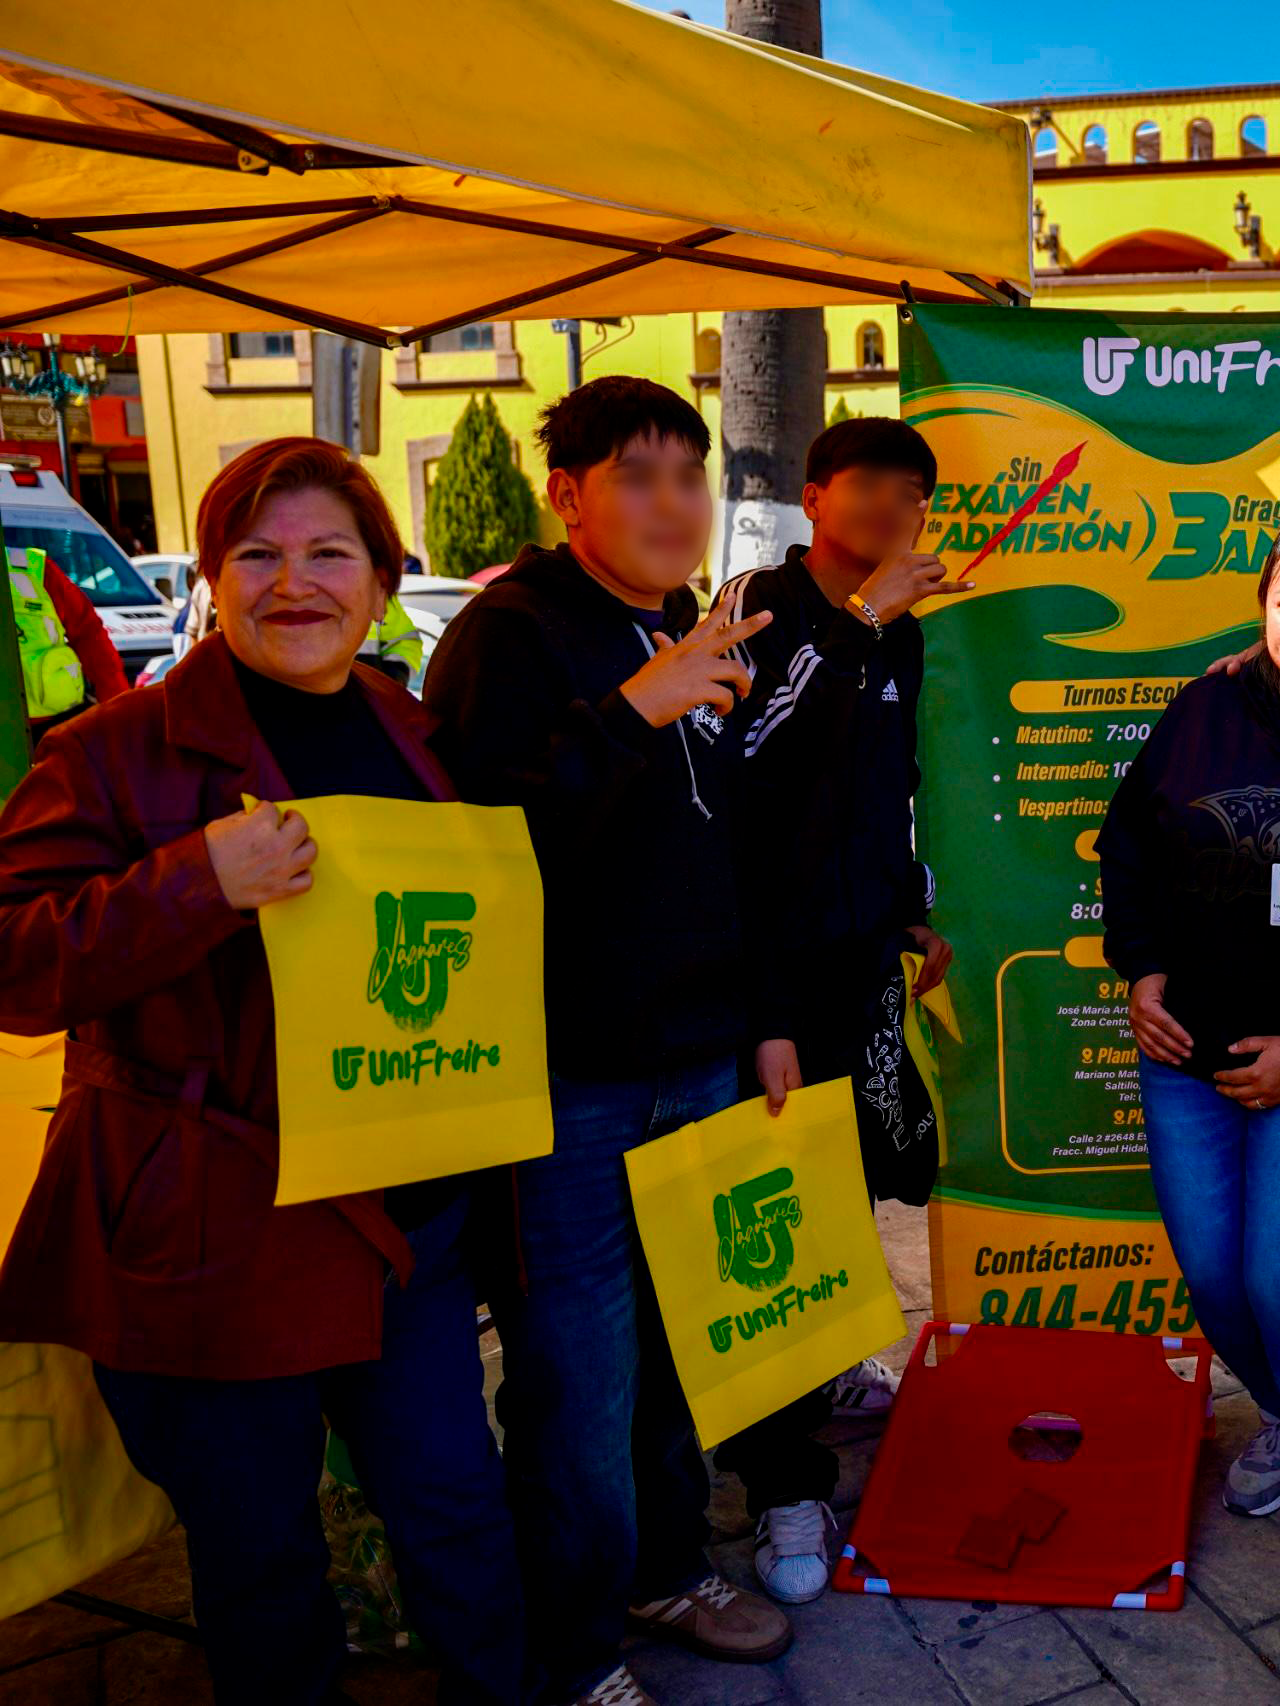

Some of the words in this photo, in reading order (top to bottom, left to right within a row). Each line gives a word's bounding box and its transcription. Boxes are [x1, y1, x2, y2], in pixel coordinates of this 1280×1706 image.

[1008, 457, 1042, 482] Sin
[930, 472, 1092, 520] EXÁMEN
[927, 519, 942, 534] de
[933, 509, 1132, 556] ADMISIÓN
[1147, 492, 1231, 580] 3
[1064, 684, 1127, 706] Turnos
[1016, 725, 1094, 744] Matutino:
[1106, 723, 1151, 741] 7:00
[1017, 760, 1109, 781] Intermedio:
[1018, 798, 1109, 820] Vespertino:
[1057, 1004, 1080, 1015] José
[1082, 1004, 1110, 1015] María
[1071, 1018, 1096, 1027] Zona
[1074, 1070, 1116, 1079] Mariano
[1119, 1092, 1136, 1102] Tel:
[1068, 1134, 1093, 1144] Calle
[1095, 1134, 1103, 1143] 2
[1104, 1132, 1135, 1142] #2648
[1052, 1147, 1083, 1156] Fracc.
[1085, 1145, 1119, 1156] Miguel
[974, 1241, 1155, 1277] Contáctanos:
